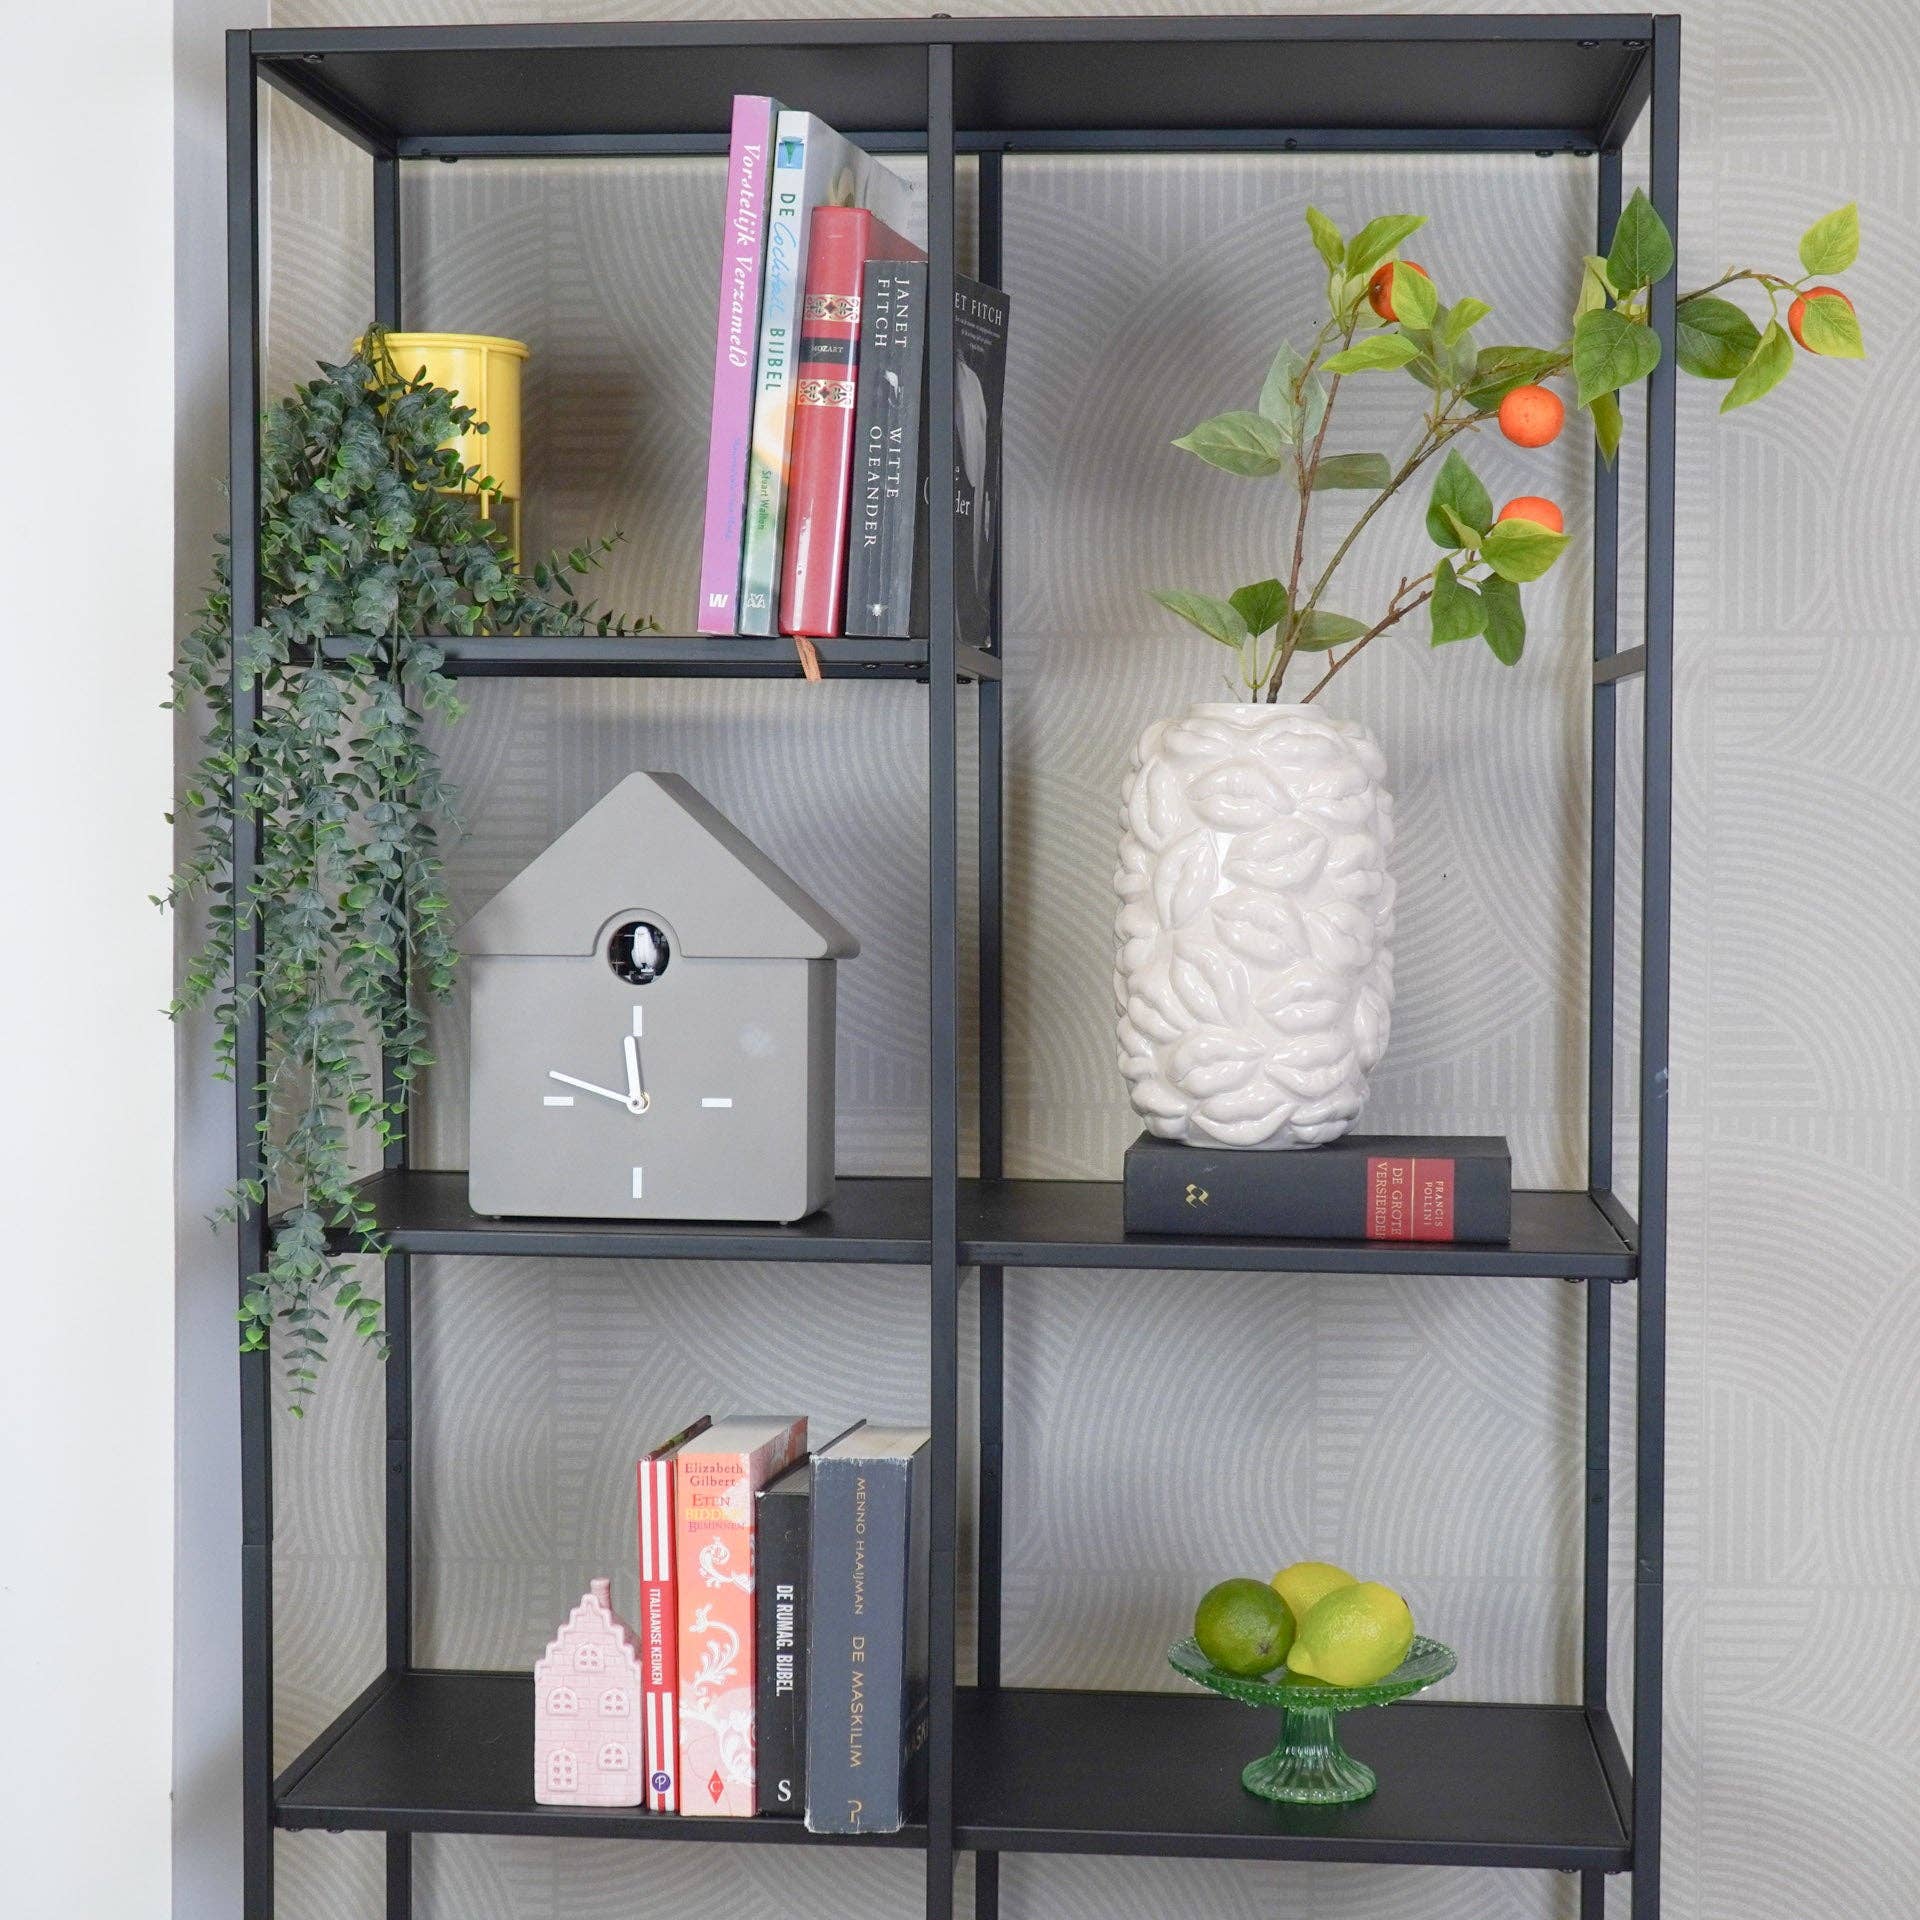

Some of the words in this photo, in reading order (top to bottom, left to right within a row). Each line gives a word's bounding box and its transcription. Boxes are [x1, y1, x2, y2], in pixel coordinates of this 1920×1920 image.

[734, 144, 761, 246] Vorstelijk
[779, 193, 796, 217] DE
[728, 255, 753, 368] Verzameld
[874, 279, 890, 347] FITCH
[894, 276, 910, 348] JANET
[971, 299, 1002, 326] FITCH
[765, 327, 786, 391] BIJBEL
[809, 344, 844, 353] MOZART
[760, 470, 772, 497] Stuart
[886, 427, 902, 498] WITTE
[863, 425, 882, 548] OLEANDER
[1392, 1167, 1403, 1185] DE
[1375, 1161, 1388, 1240] VERSIERDER
[1391, 1190, 1403, 1235] GROTE
[1424, 1181, 1433, 1226] POLLINI
[1434, 1180, 1444, 1228] FRANCIS
[685, 1462, 743, 1474] Elizabeth
[690, 1475, 737, 1487] Gilbert
[856, 1477, 866, 1535] MENNO
[776, 1585, 794, 1601] DE
[852, 1540, 865, 1616] HAAIJMAN
[776, 1604, 794, 1651] RUMAG.
[852, 1636, 865, 1663] DE
[650, 1647, 664, 1686] KEUKEN
[850, 1670, 865, 1768] MASKILIM
[777, 1779, 792, 1802] S
